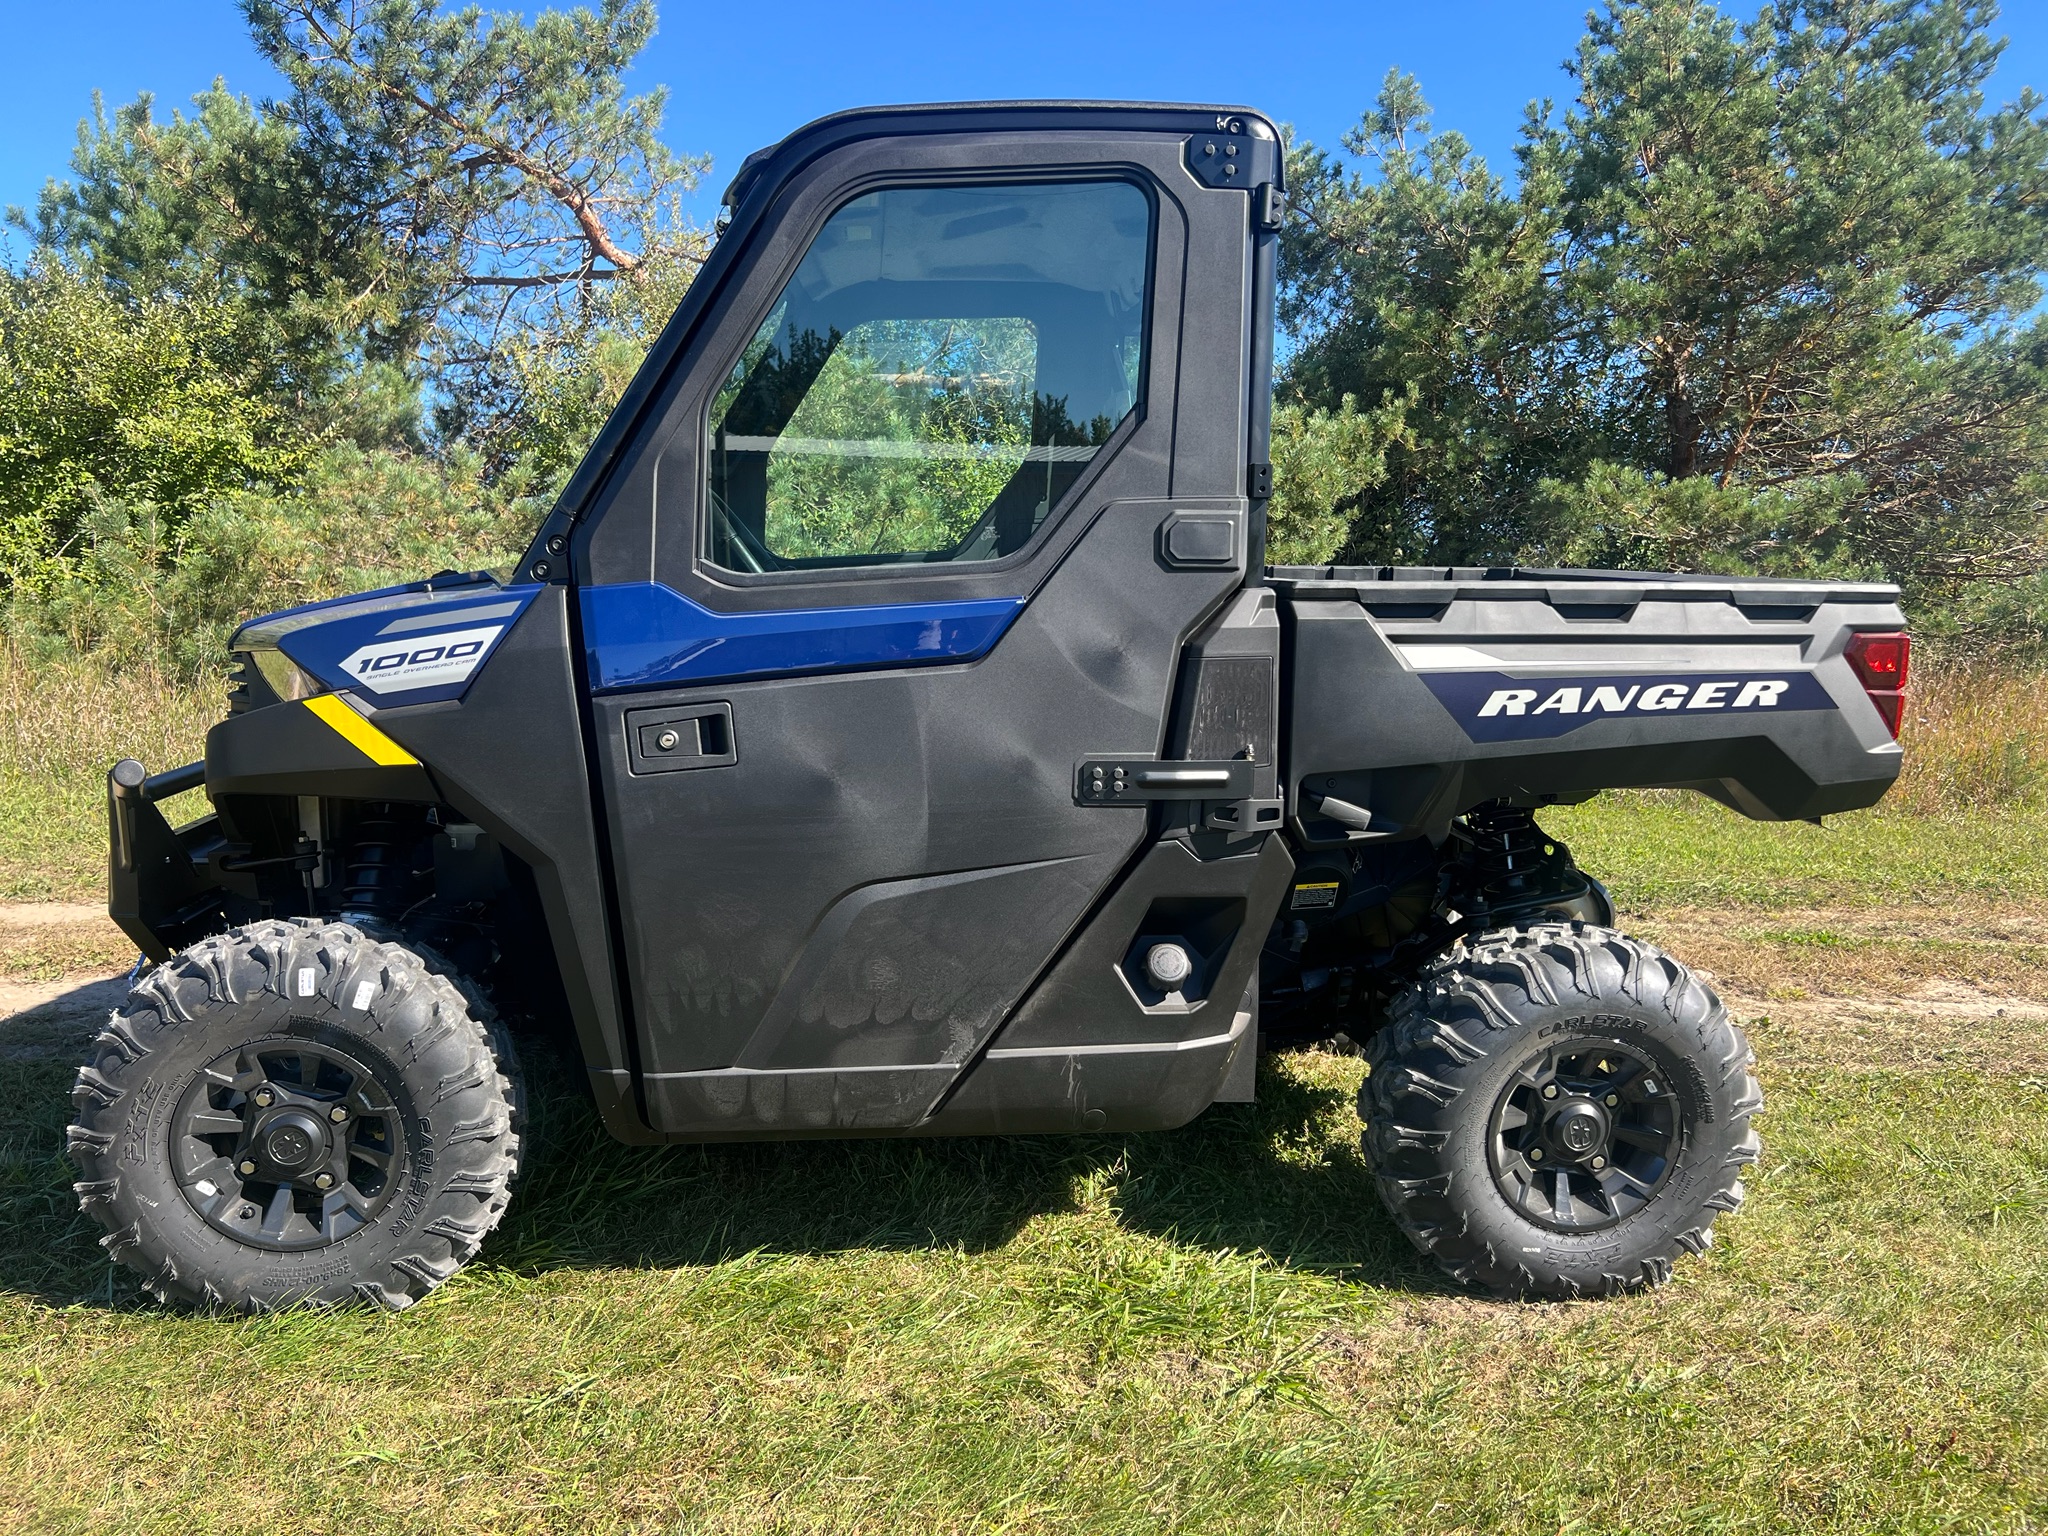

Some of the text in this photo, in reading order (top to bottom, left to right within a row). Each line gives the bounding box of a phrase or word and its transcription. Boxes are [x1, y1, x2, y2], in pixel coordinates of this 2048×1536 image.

[358, 641, 484, 674] 1000
[366, 658, 477, 680] SINGLE OVERHEAD CAM
[1477, 680, 1790, 717] RANGER
[1538, 1013, 1648, 1040] CARLSTAR
[154, 1109, 162, 1125] UTV
[160, 1094, 170, 1107] USE
[168, 1073, 183, 1091] ONLY
[389, 1116, 434, 1237] CARLSTAR
[262, 1276, 288, 1287] NHS
